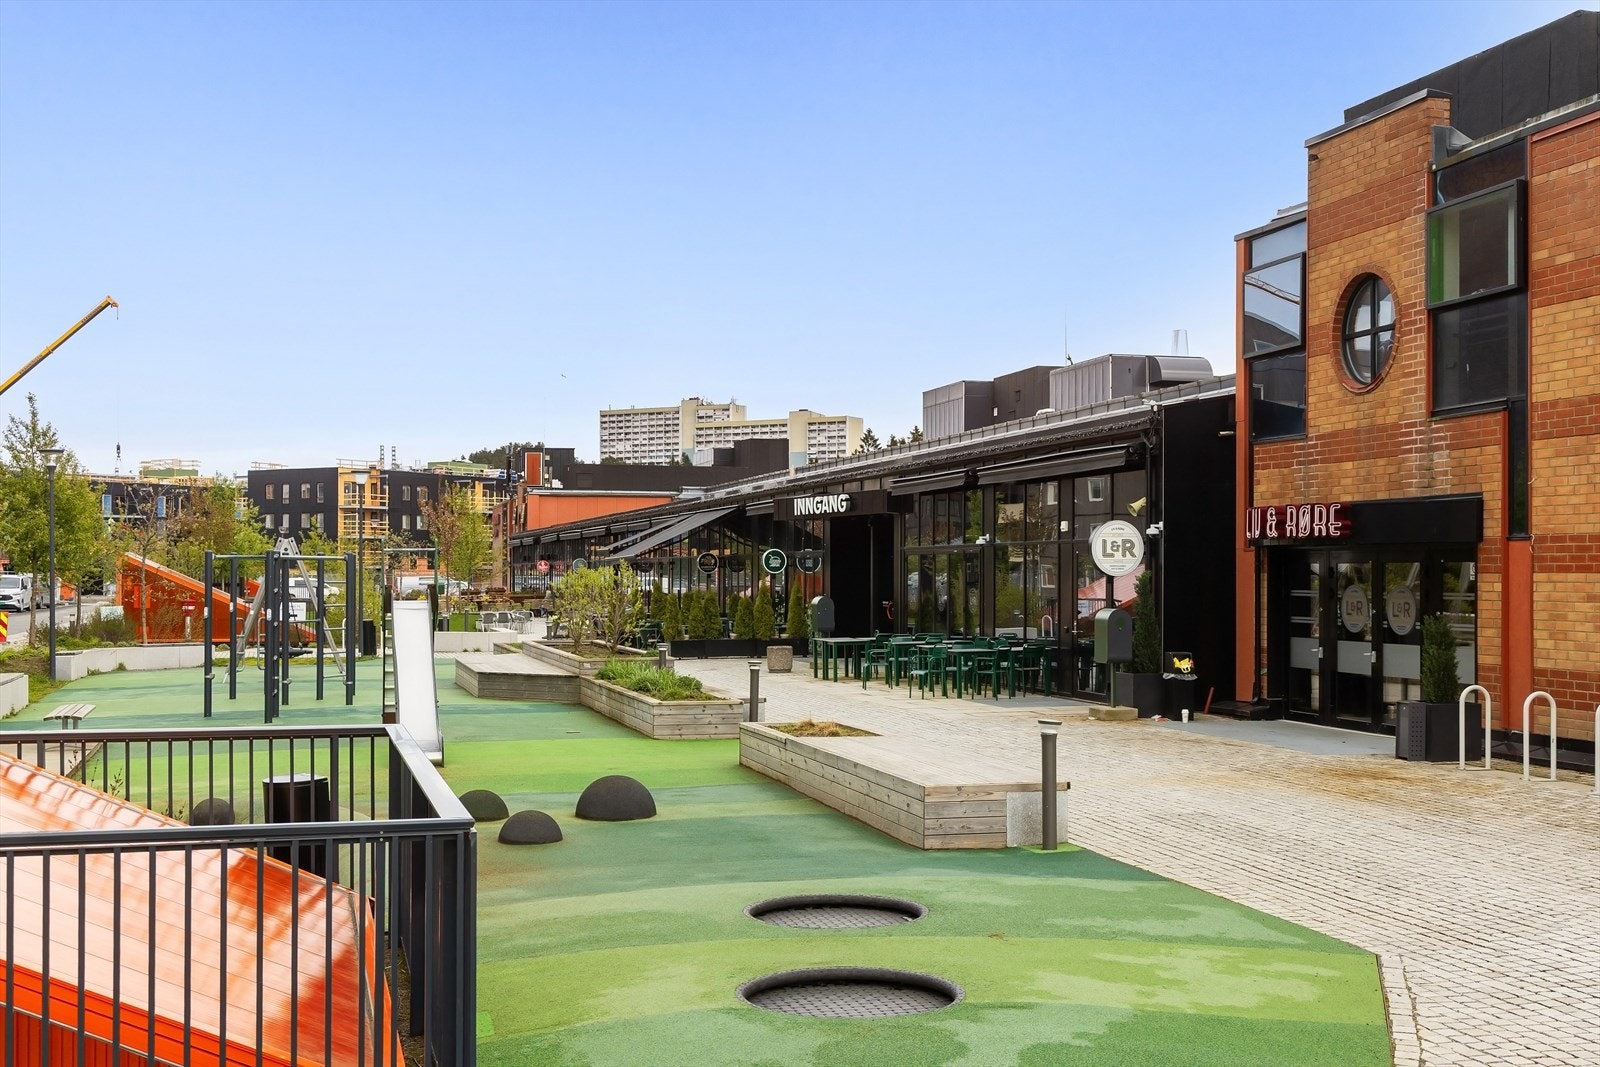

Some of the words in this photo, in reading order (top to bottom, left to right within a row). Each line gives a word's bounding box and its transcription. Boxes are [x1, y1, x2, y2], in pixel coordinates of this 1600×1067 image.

[794, 494, 850, 516] INNGANG
[1266, 506, 1278, 538] &
[1285, 503, 1342, 537] RØRE
[1101, 538, 1137, 558] L&R
[1345, 600, 1364, 616] L&R
[1392, 601, 1411, 618] L&R
